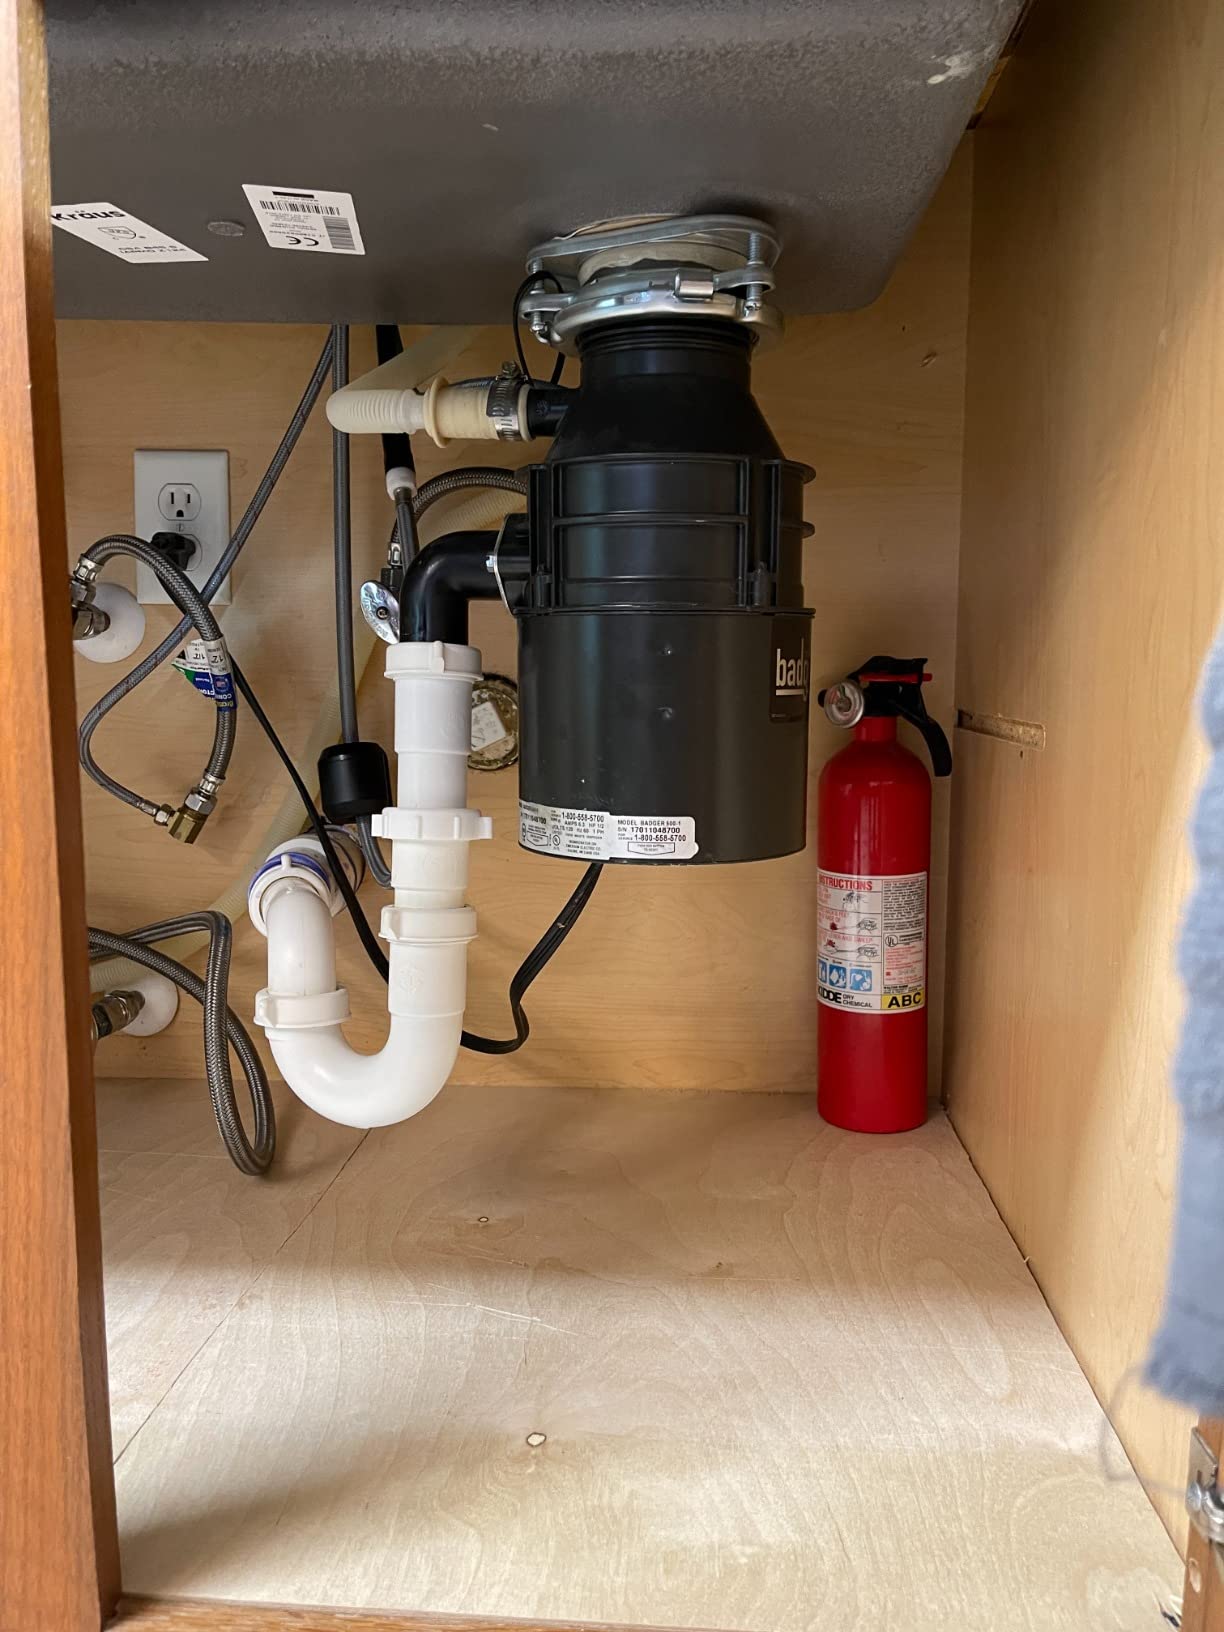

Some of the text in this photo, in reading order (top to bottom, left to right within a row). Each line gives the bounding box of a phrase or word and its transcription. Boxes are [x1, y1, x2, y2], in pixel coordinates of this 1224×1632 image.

[285, 235, 319, 247] CE
[561, 811, 604, 823] 1-800-558-5700
[634, 834, 687, 842] 1-800-558-5700
[842, 999, 873, 1008] CHEMICAL
[887, 991, 923, 1009] ABC
